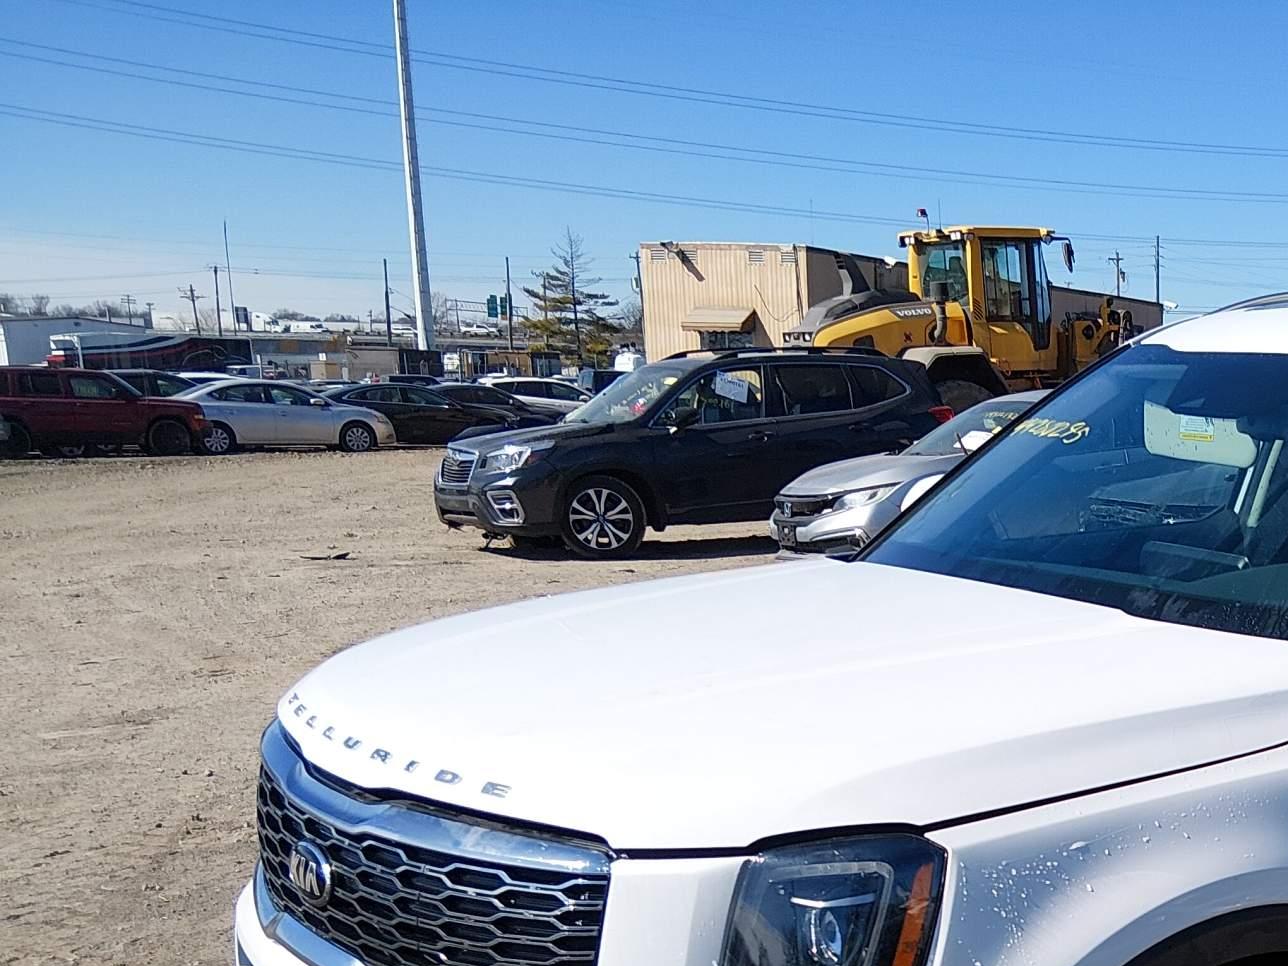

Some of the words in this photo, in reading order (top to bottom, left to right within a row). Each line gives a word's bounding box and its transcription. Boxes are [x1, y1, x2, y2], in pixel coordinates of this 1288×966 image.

[895, 308, 932, 317] VOLVO
[288, 692, 512, 798] TELLURIDE
[288, 849, 322, 898] KIA
